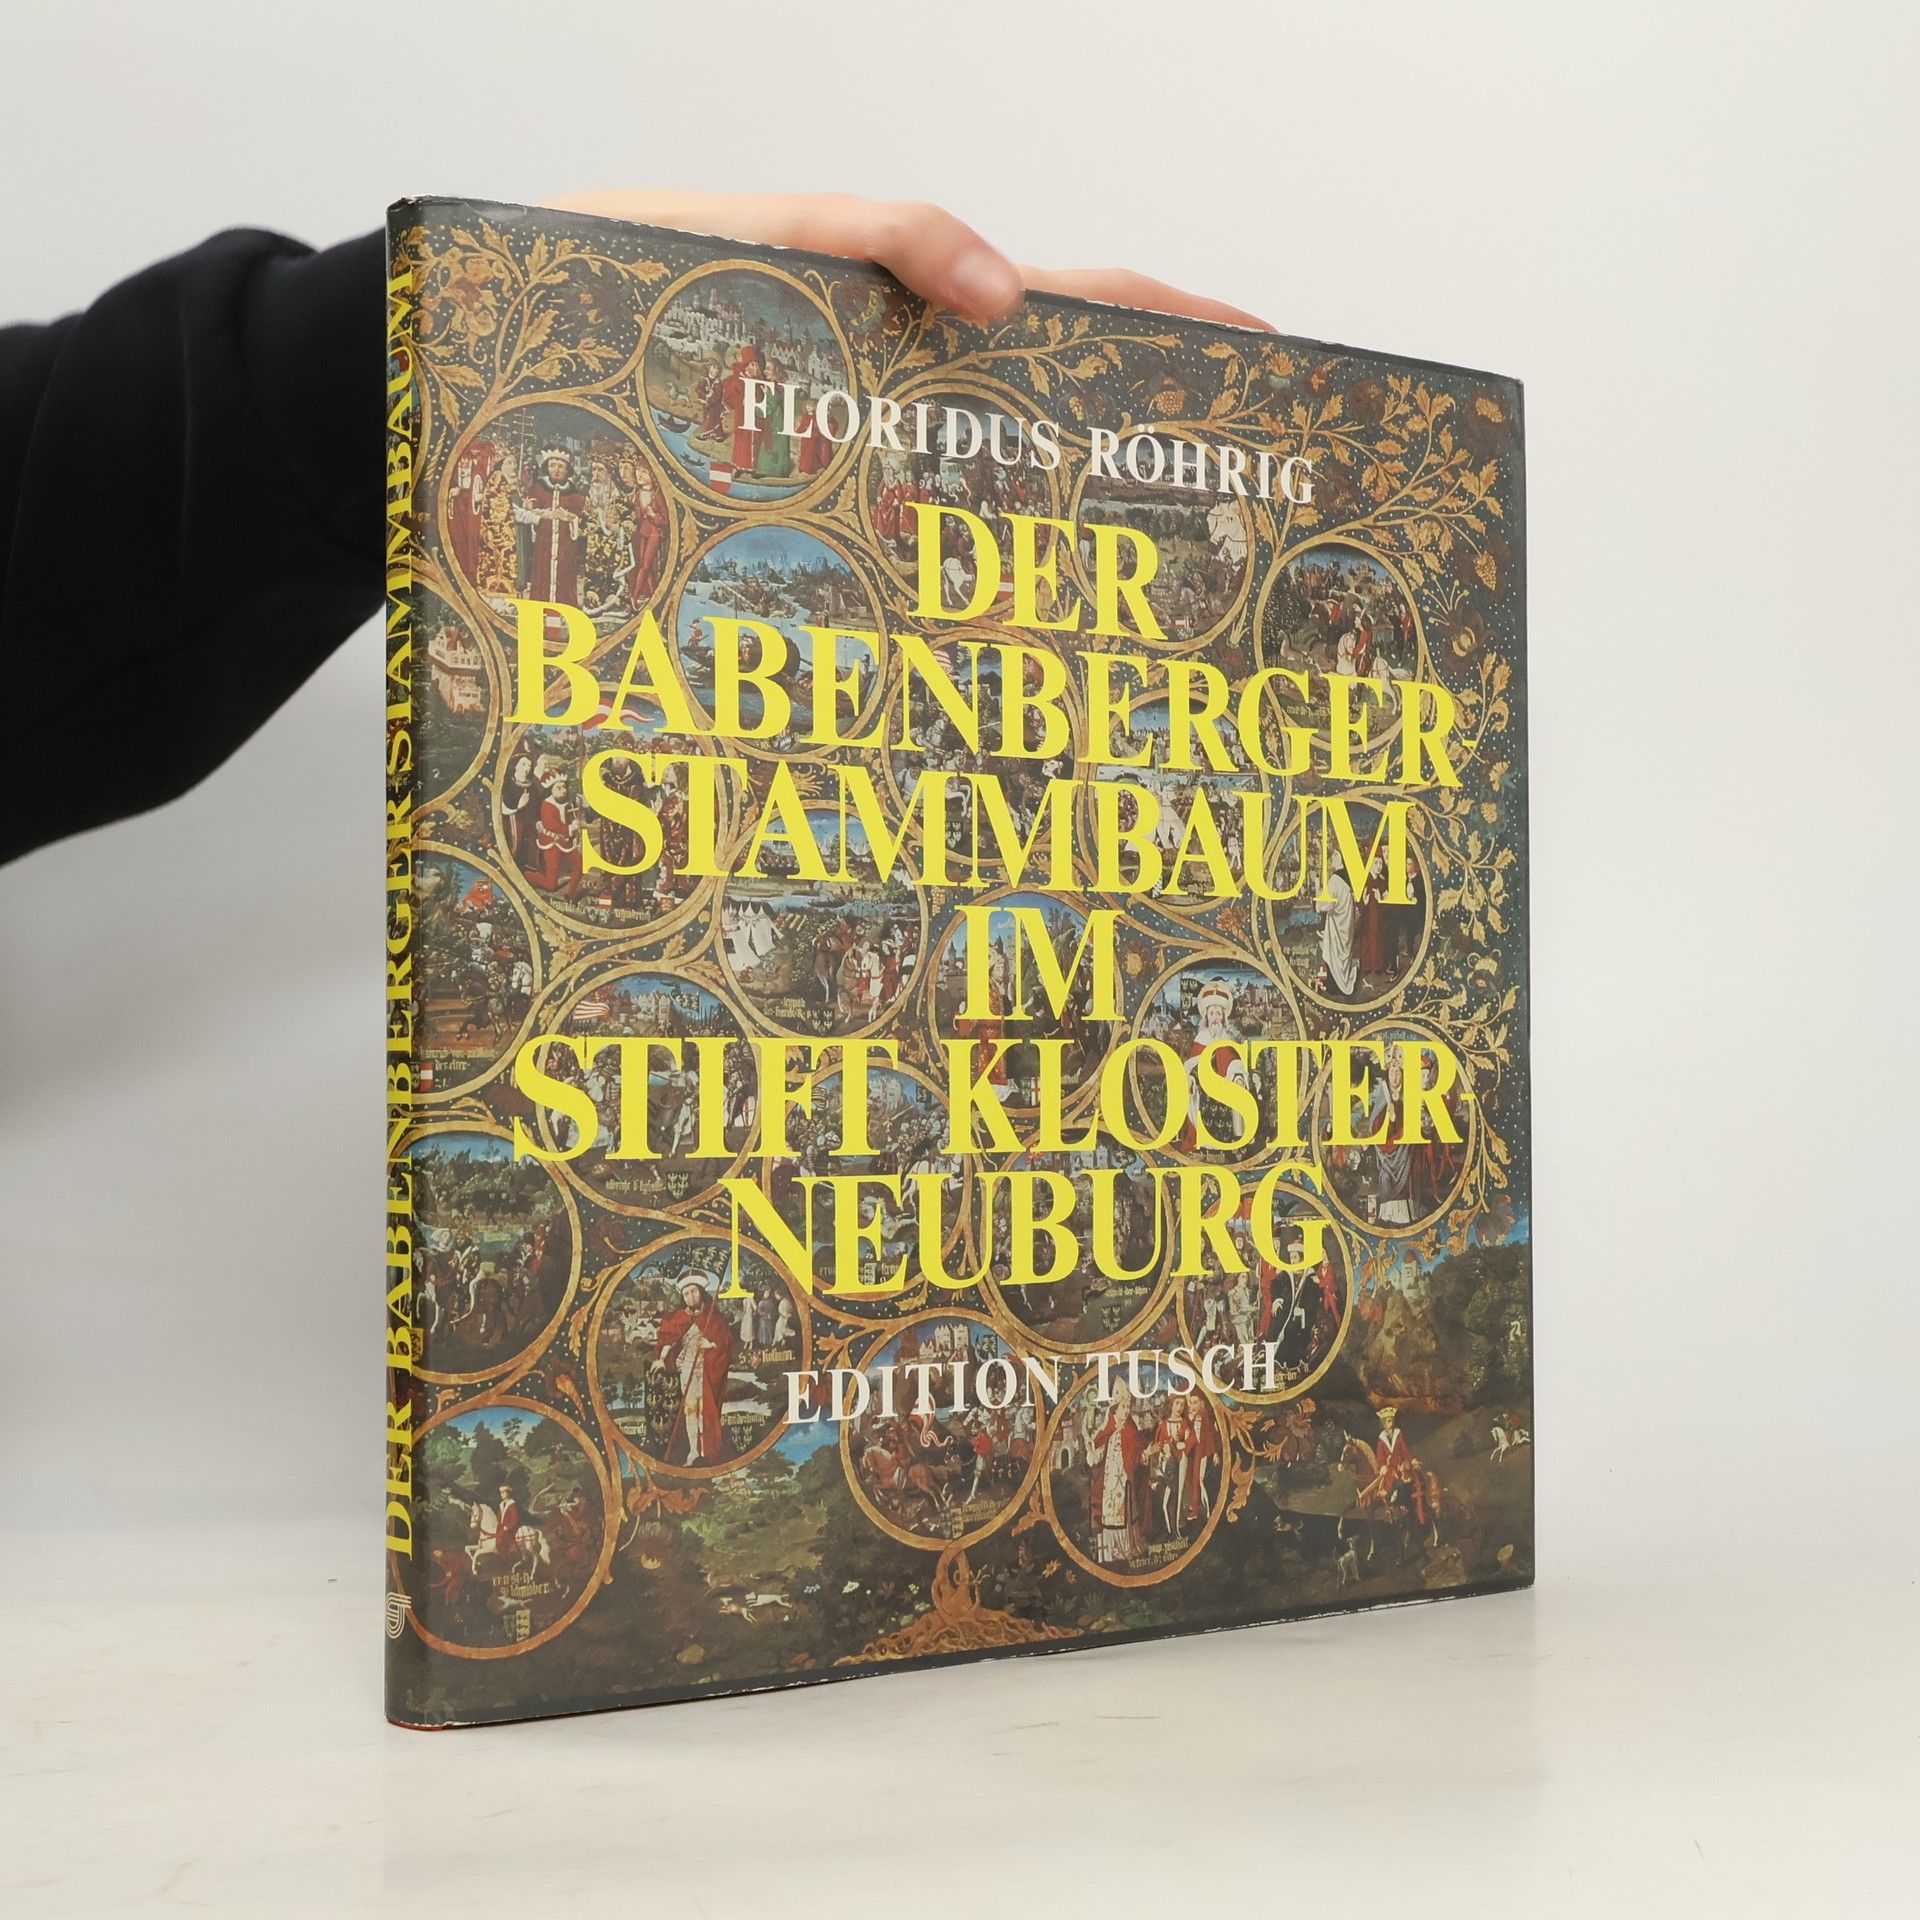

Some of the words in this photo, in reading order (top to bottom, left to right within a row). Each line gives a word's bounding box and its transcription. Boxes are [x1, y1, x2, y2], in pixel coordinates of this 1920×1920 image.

[739, 377, 1061, 471] FLORIDUS
[1087, 424, 1316, 506] RÖHRIG
[905, 501, 1168, 641] DER
[503, 598, 1477, 791] BABENBERGER-
[581, 748, 1417, 905] STAMMBAUM
[955, 905, 1126, 1023] IM
[512, 1034, 900, 1163] STIFT
[939, 1034, 1477, 1156] KLOSTER-
[716, 1160, 1332, 1302] NEUBURG
[783, 1355, 1061, 1426] EDITION
[1086, 1339, 1280, 1402] TUSCH
[386, 1398, 412, 1562] DER
